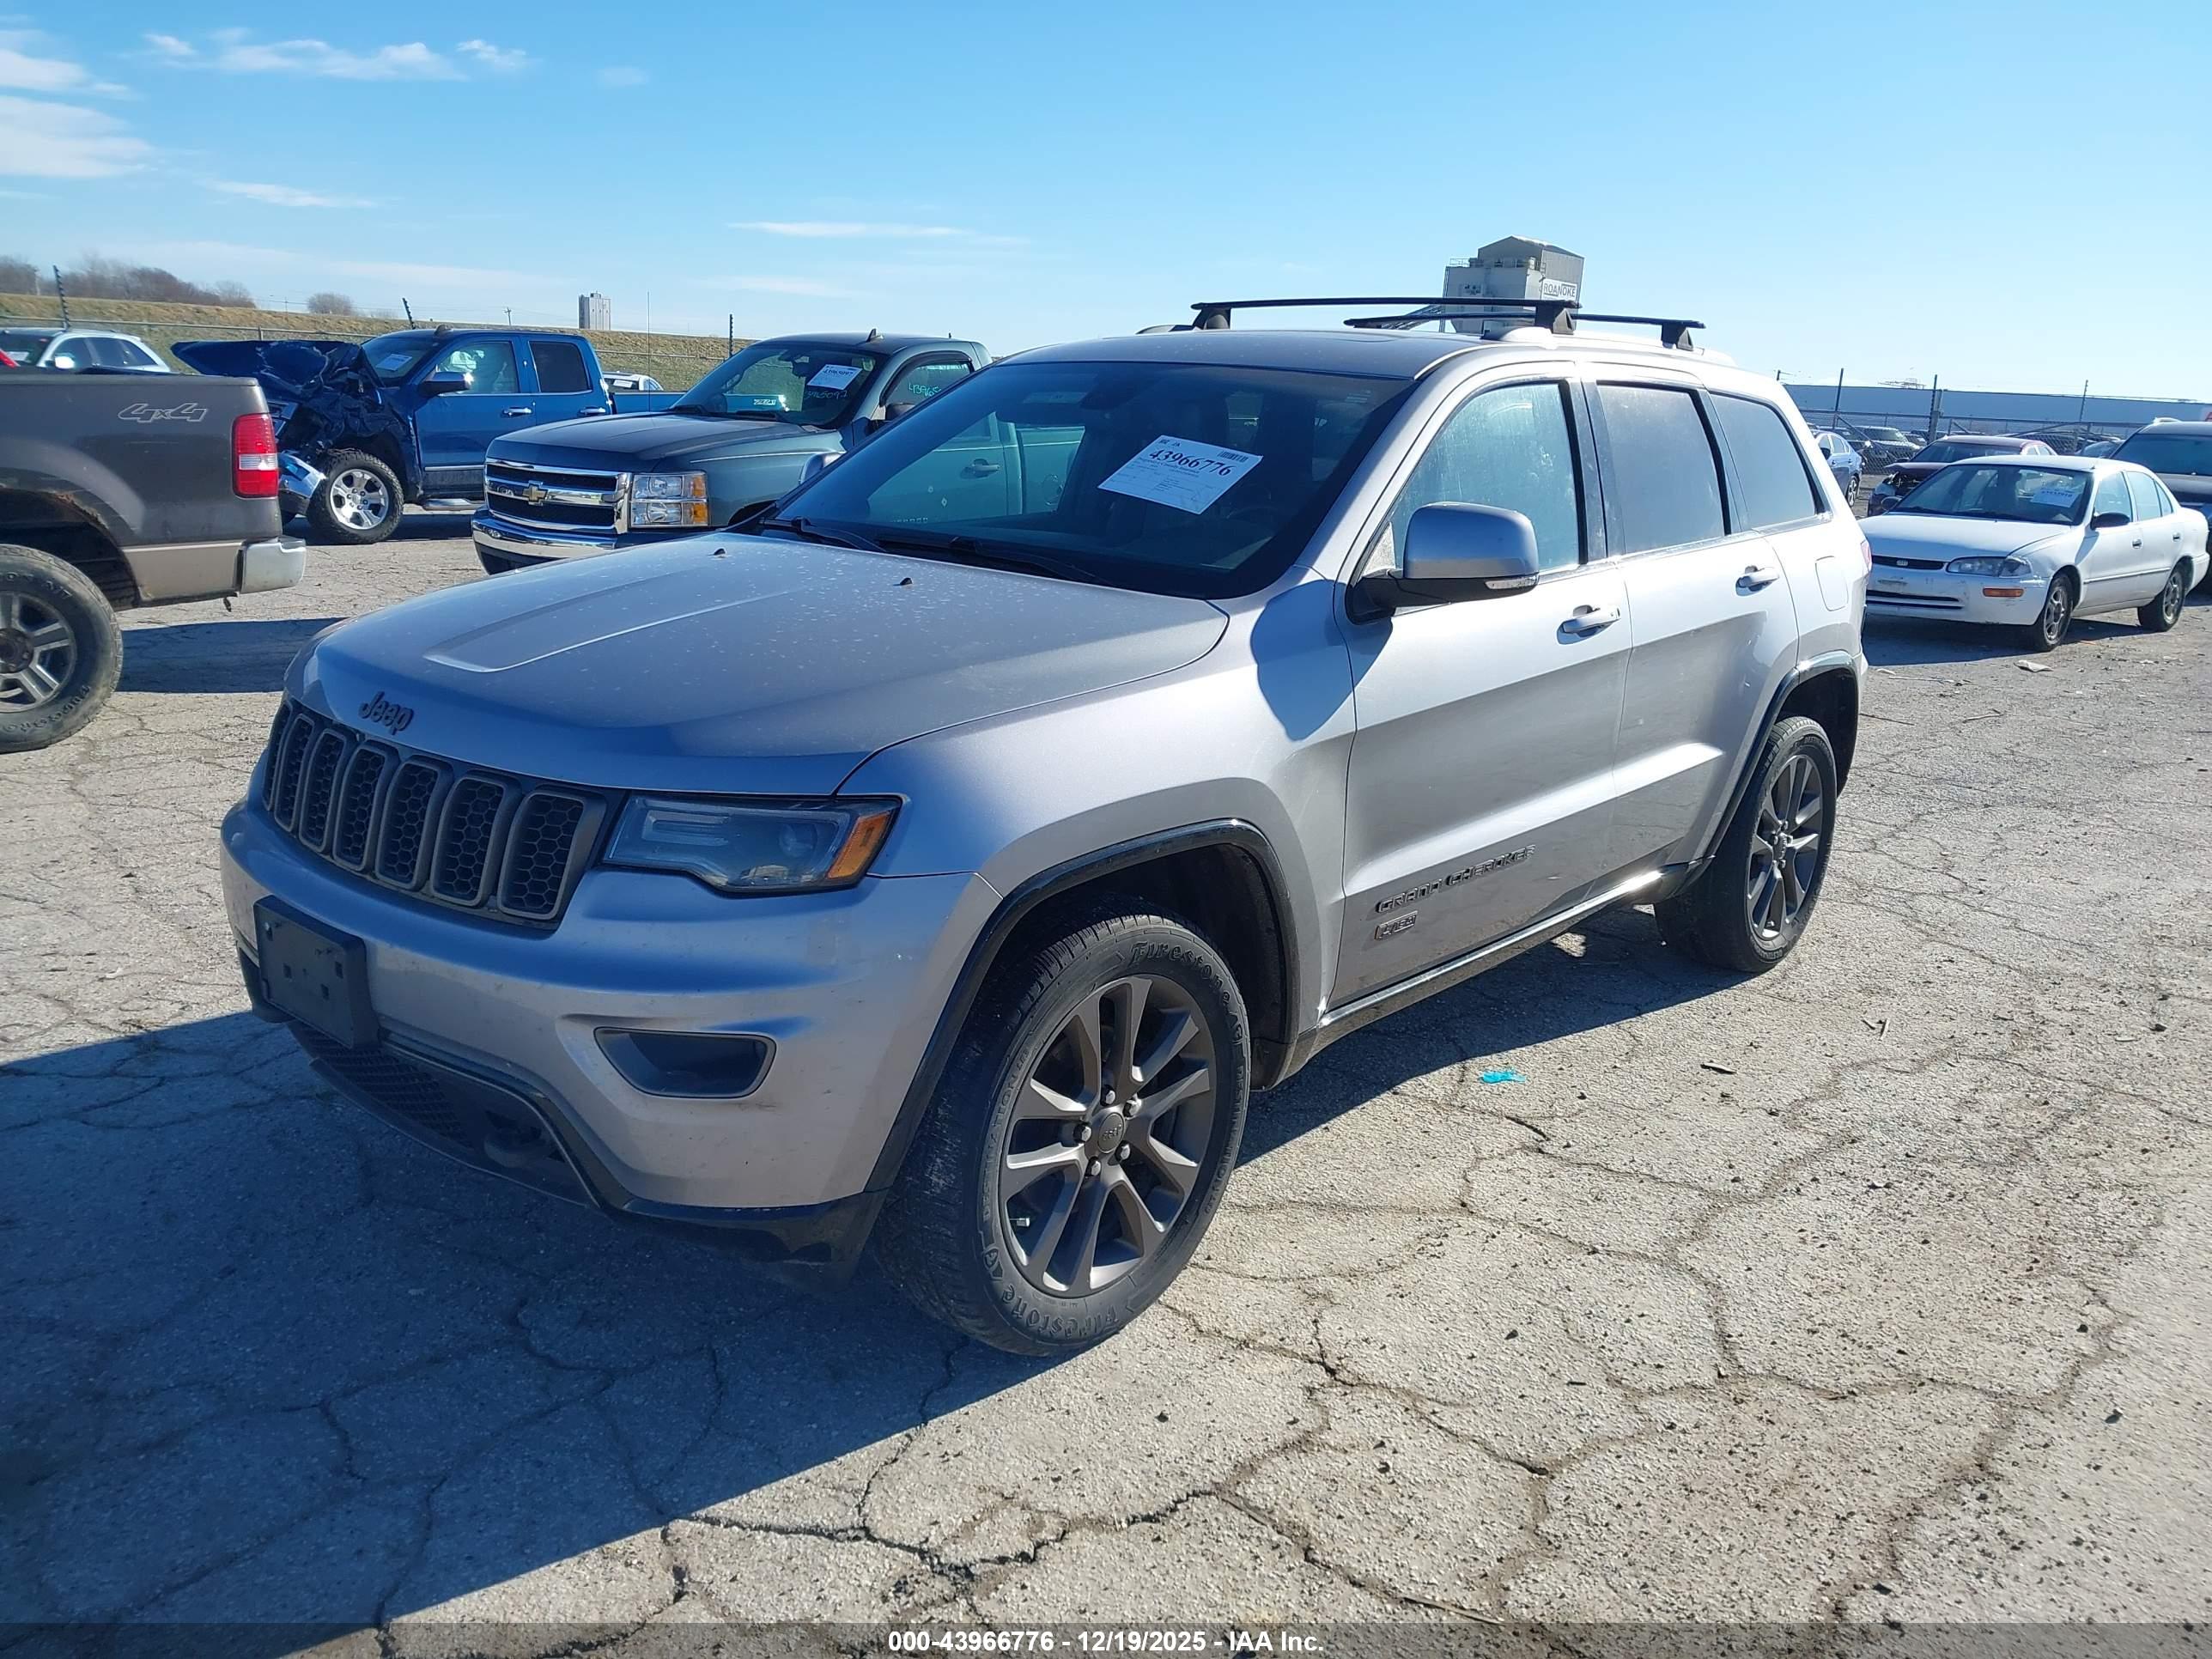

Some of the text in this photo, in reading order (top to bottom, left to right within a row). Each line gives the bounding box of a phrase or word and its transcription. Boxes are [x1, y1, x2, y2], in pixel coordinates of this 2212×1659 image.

[1544, 283, 1577, 298] ROANOKE
[118, 403, 208, 423] 4x4
[1149, 449, 1237, 477] 43966776
[358, 691, 414, 735] Jeep
[1376, 844, 1536, 913] GRAND CHEROKEE
[1127, 941, 1231, 1006] Firestone
[1002, 1285, 1120, 1339] Firestone
